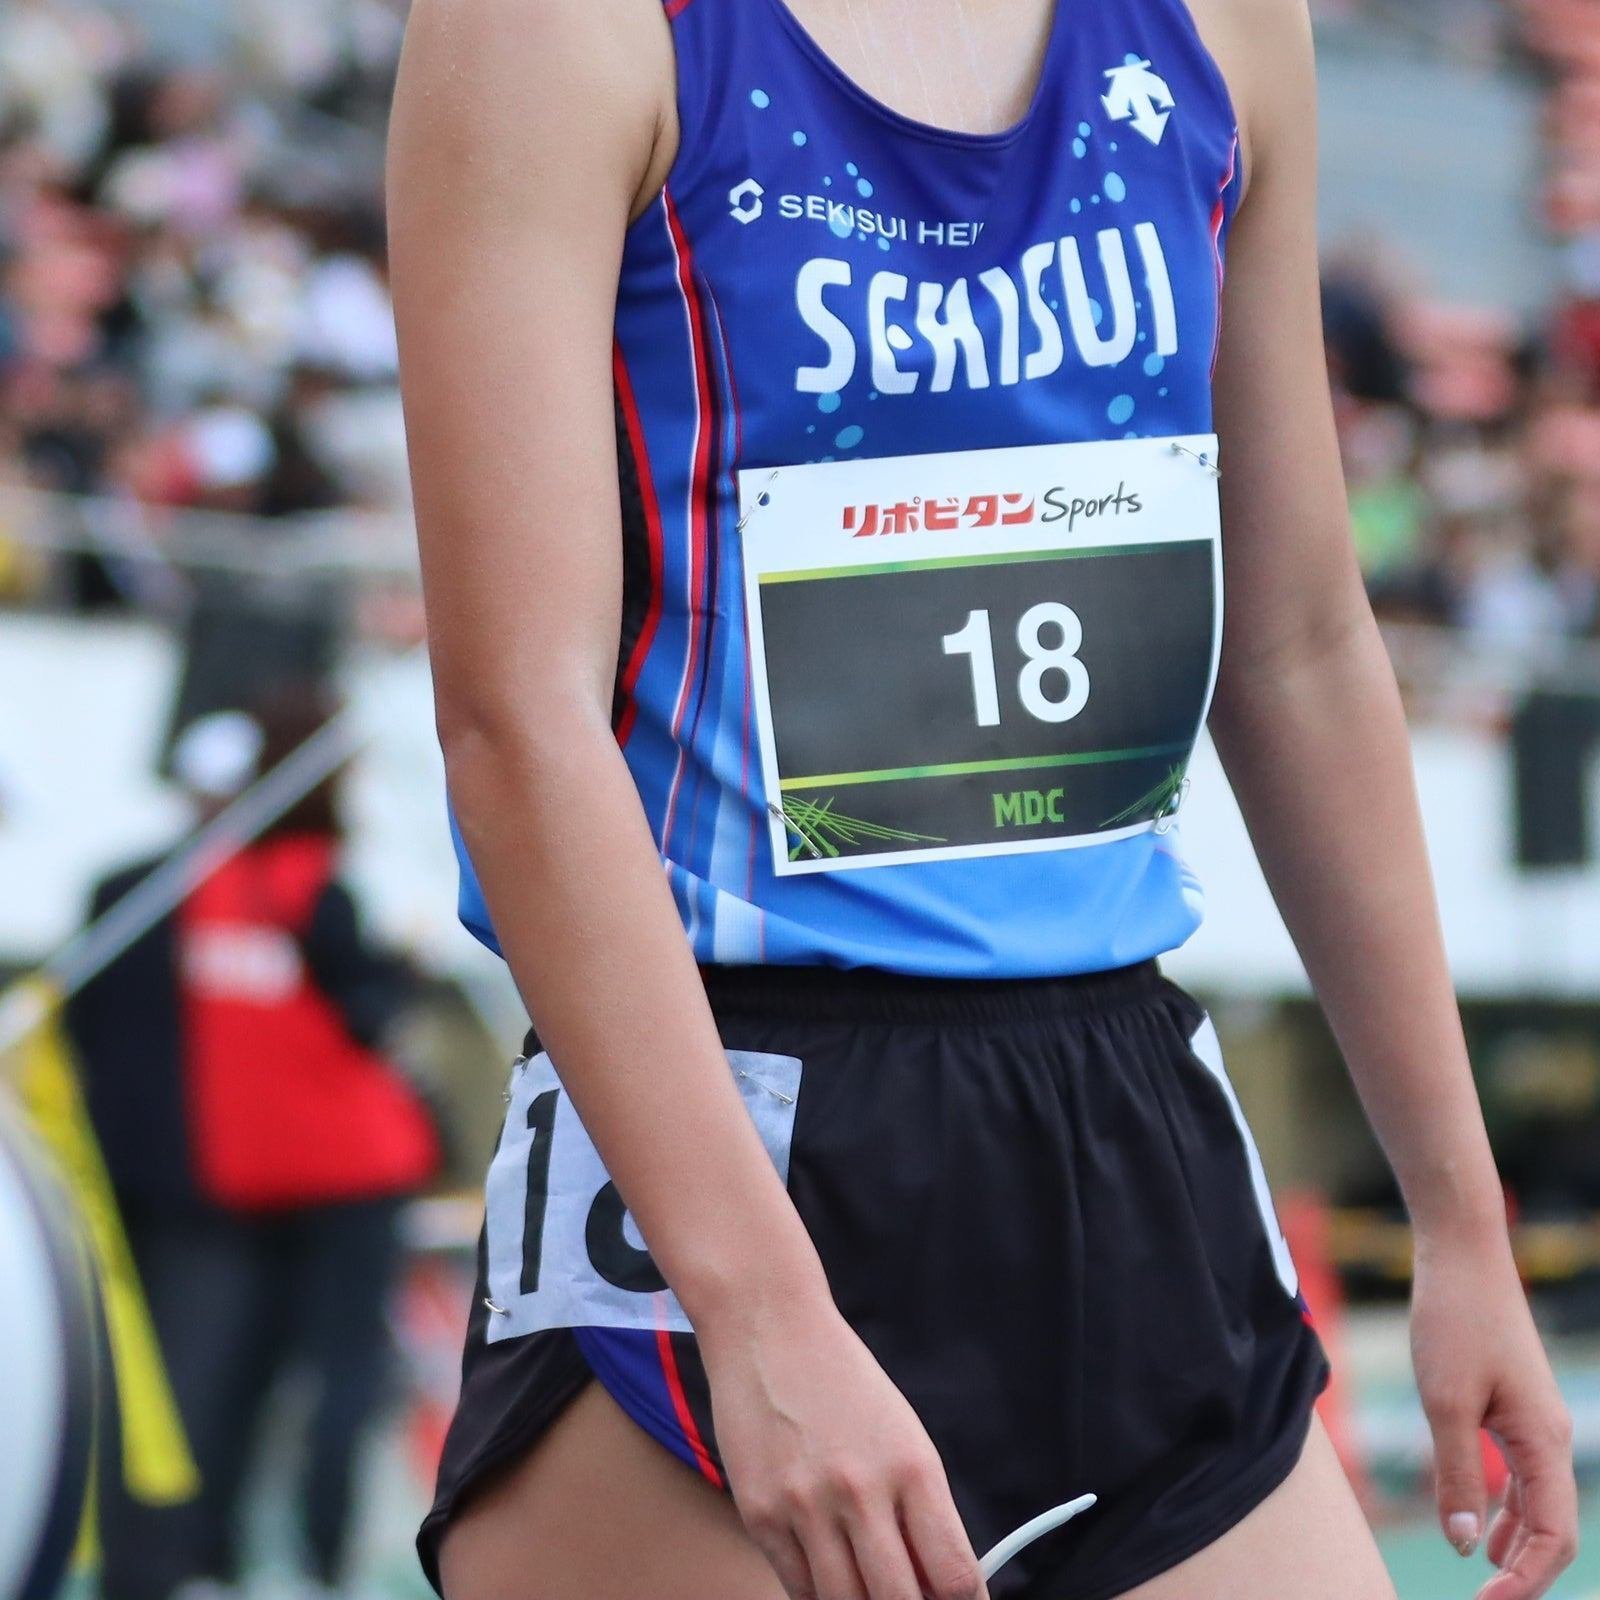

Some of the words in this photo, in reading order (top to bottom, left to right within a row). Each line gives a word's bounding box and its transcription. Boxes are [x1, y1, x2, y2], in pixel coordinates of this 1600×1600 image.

[779, 195, 908, 241] SEKISUI
[917, 221, 985, 247] HEI
[795, 222, 1179, 395] SEKISUI
[842, 492, 1034, 538] リポビタン
[1040, 481, 1142, 532] Sports
[941, 602, 1090, 727] 18
[992, 788, 1064, 827] MDC
